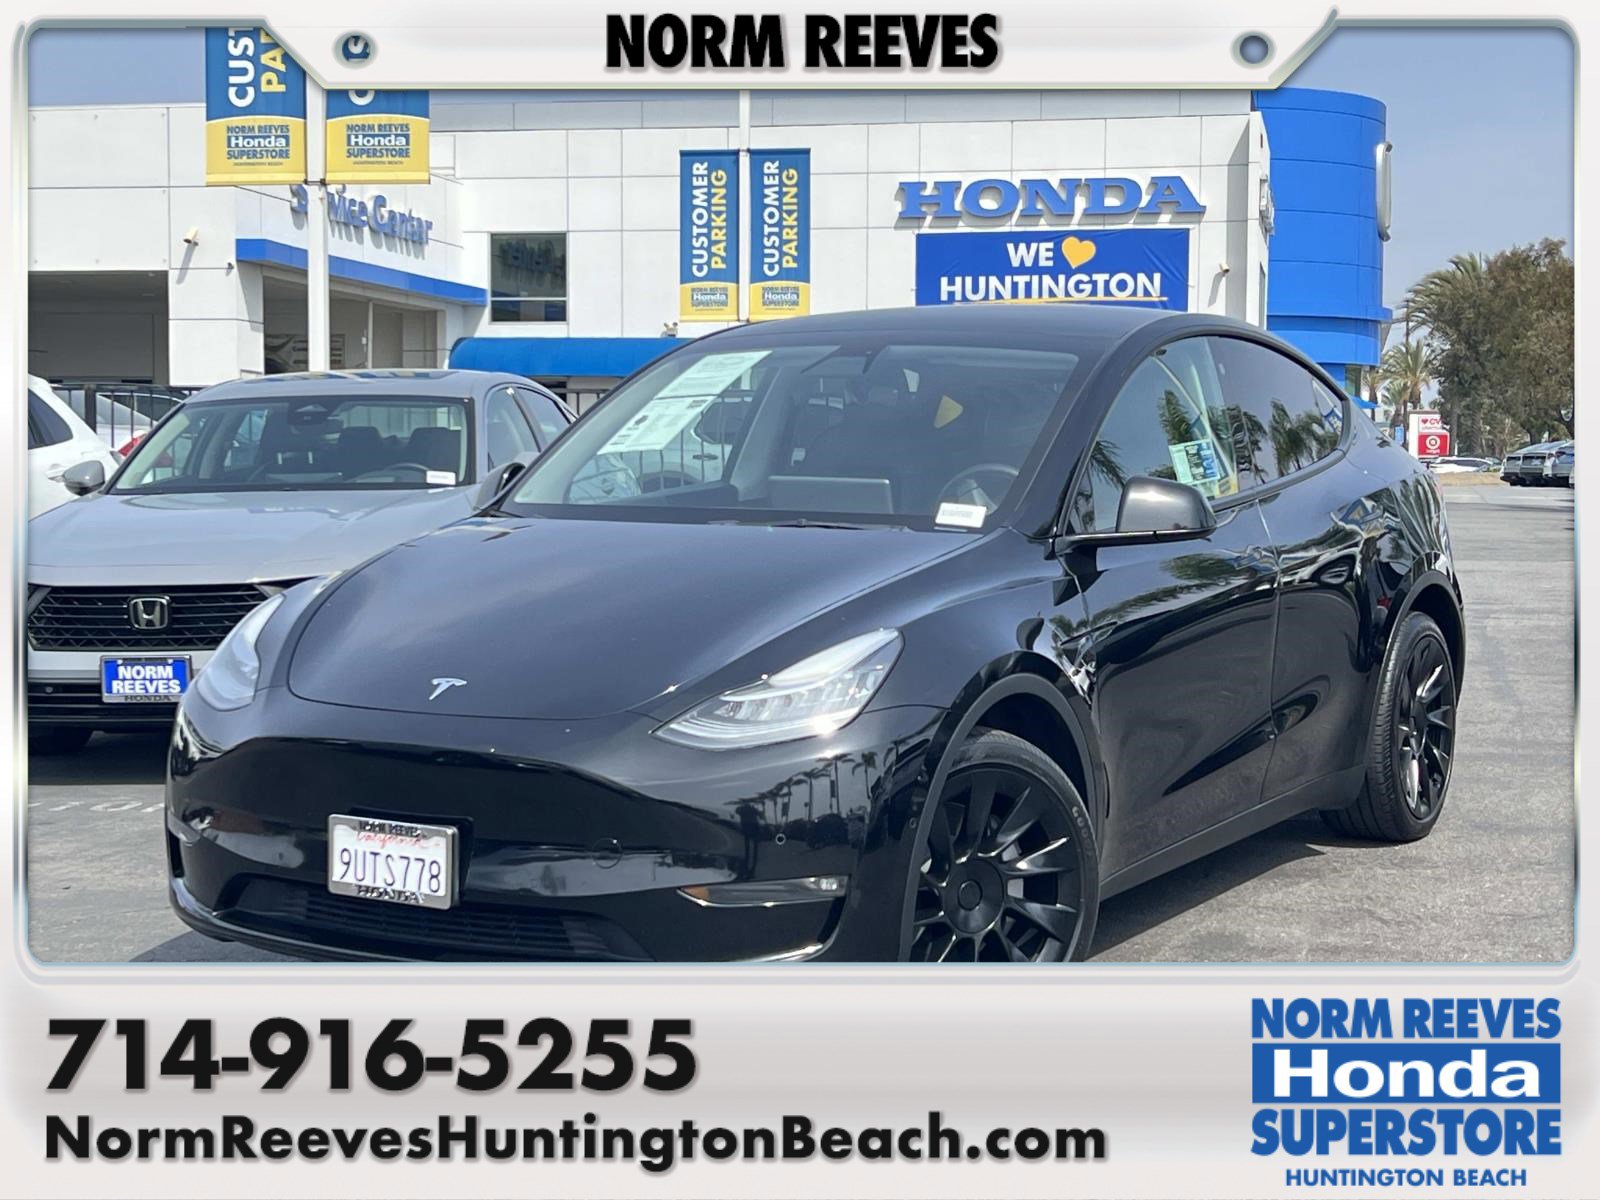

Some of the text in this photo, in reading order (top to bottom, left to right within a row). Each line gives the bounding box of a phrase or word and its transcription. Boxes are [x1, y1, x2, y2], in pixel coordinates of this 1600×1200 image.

[226, 124, 290, 134] NORM REEVES
[346, 123, 410, 133] NORM REEVES
[230, 135, 287, 148] Honda
[350, 134, 407, 146] Honda
[226, 149, 290, 160] SUPERSTORE
[346, 147, 411, 158] SUPERSTORE
[899, 175, 1206, 218] HONDA
[369, 194, 433, 245] Center
[692, 161, 709, 278] CUSTOMER
[711, 169, 727, 269] PARKING
[763, 160, 780, 277] CUSTOMER
[782, 168, 798, 268] PARKING
[1006, 241, 1054, 268] WE
[940, 272, 1162, 302] HUNTINGTON
[117, 665, 174, 680] NORM
[112, 679, 182, 695] REEVES
[123, 694, 172, 702] HONDA
[340, 848, 441, 894] 9UTS778
